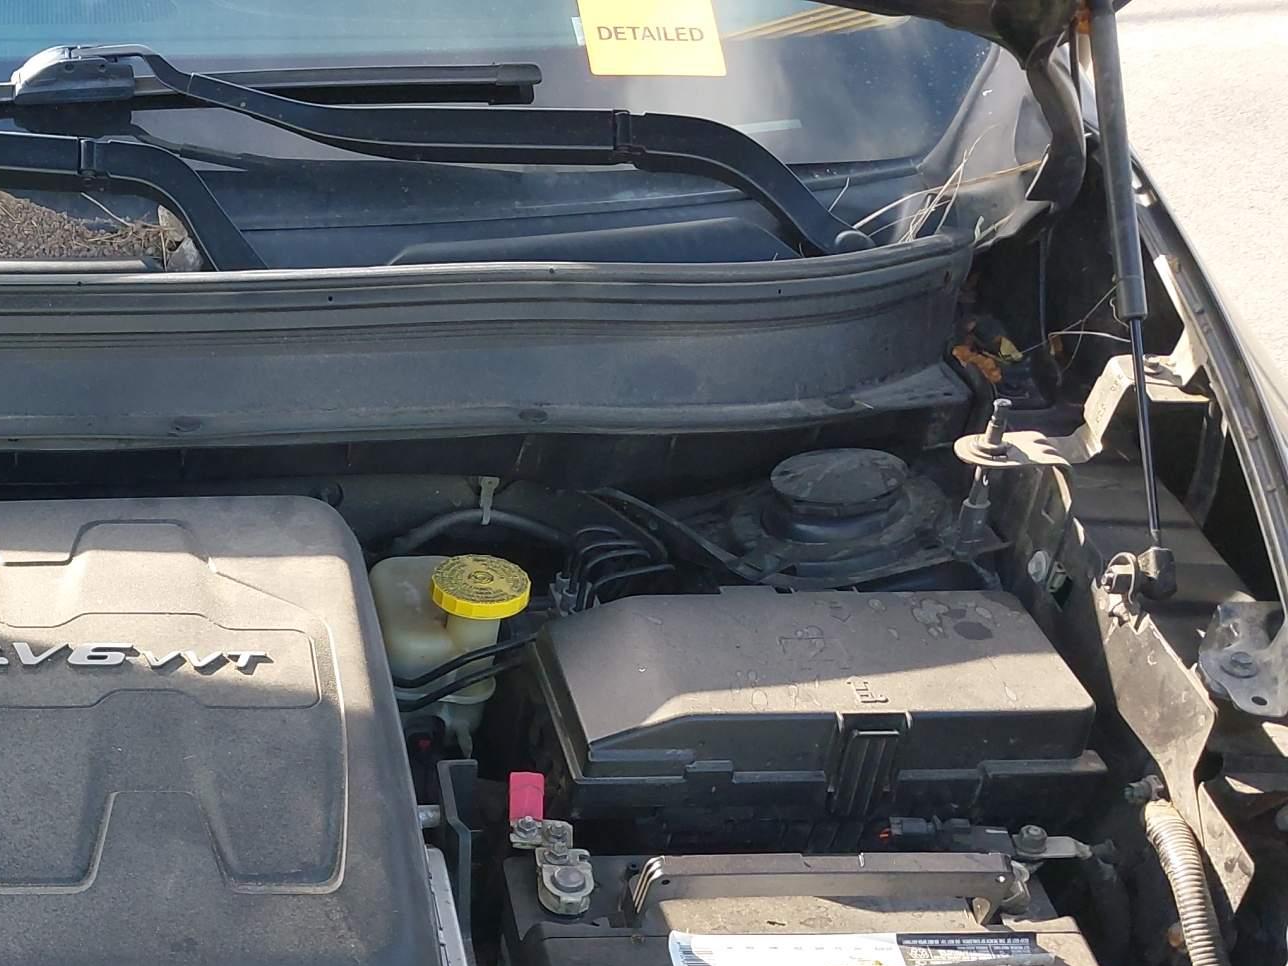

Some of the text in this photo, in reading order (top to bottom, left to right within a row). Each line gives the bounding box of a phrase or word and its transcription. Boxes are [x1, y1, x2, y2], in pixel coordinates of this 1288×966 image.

[596, 26, 704, 42] DETAILED
[12, 642, 273, 675] V6 VVT
